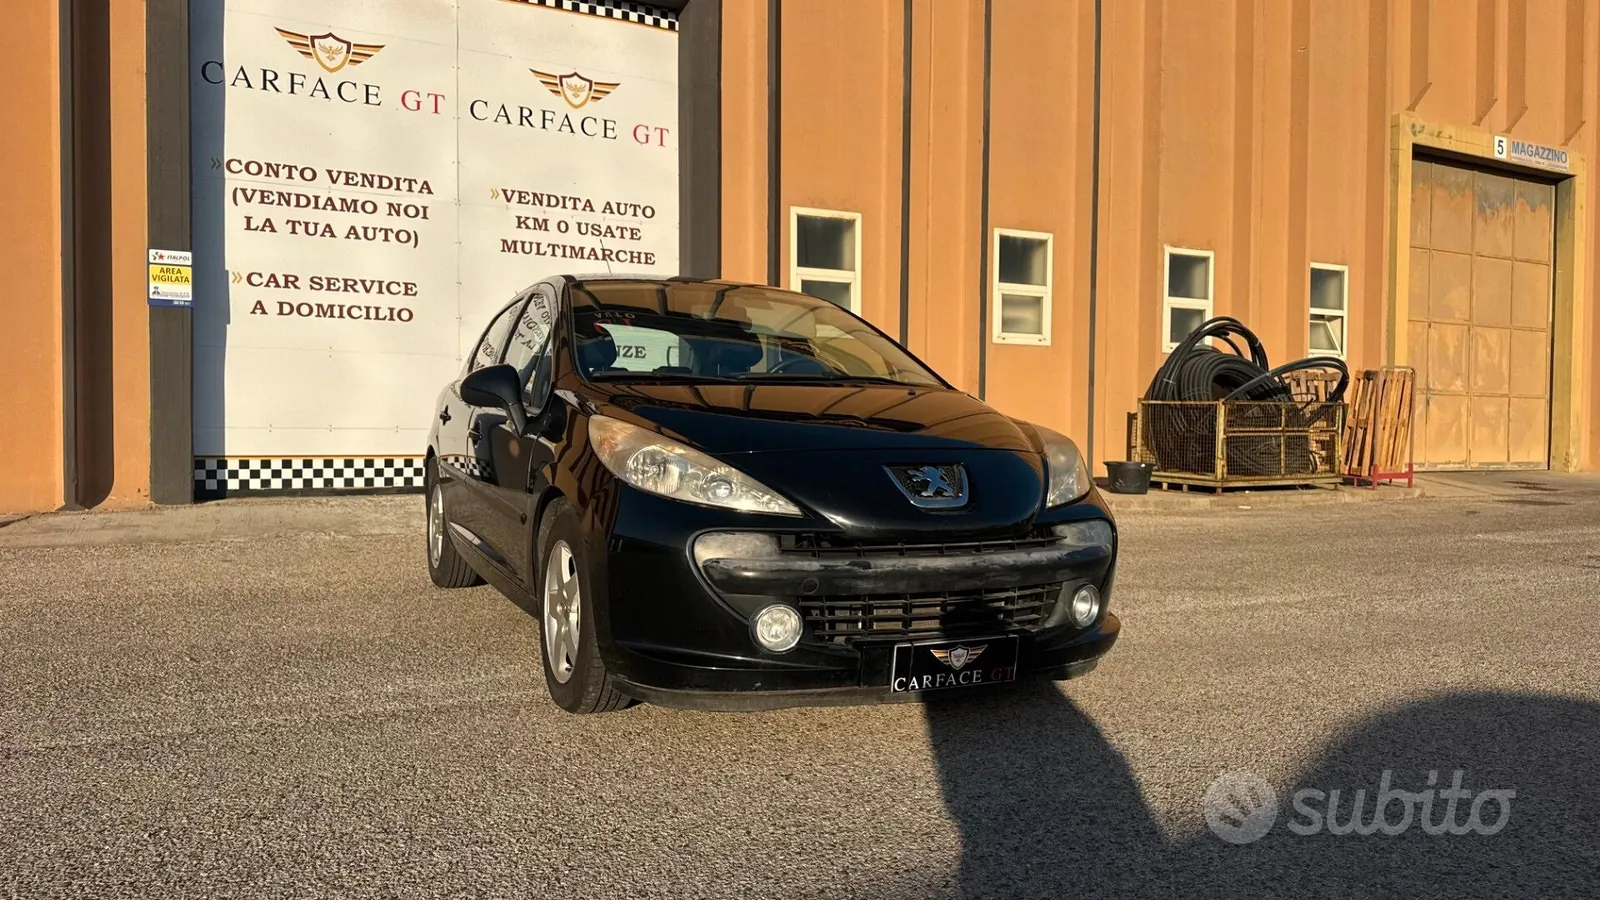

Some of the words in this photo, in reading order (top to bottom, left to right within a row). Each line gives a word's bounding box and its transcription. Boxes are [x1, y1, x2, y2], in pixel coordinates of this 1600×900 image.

[201, 60, 382, 106] CARFACE
[400, 89, 446, 115] GT
[469, 99, 618, 140] CARFACE
[632, 123, 670, 147] GT
[1497, 139, 1504, 155] 5
[1511, 140, 1567, 163] MAGAZZINO
[225, 158, 318, 182] CONTO
[325, 168, 434, 195] VENDITA
[232, 187, 378, 215] (VENDIAMO
[386, 202, 429, 220] NOI
[501, 188, 595, 213] VENDITA
[601, 201, 656, 219] AUTO
[244, 215, 277, 233] LA
[285, 219, 337, 239] TUA
[344, 225, 419, 249] AUTO)
[515, 215, 550, 232] KM
[576, 222, 642, 241] USATE
[167, 254, 190, 262] ITALPOL
[500, 238, 656, 266] MULTIMARCHE
[152, 274, 190, 284] VIGILATA
[159, 267, 182, 275] AREA
[246, 271, 301, 290] CAR
[309, 276, 418, 297] SERVICE
[250, 299, 268, 315] A
[276, 301, 414, 322] DOMICILIO
[894, 669, 982, 692] CARFACE
[991, 667, 1015, 681] GT
